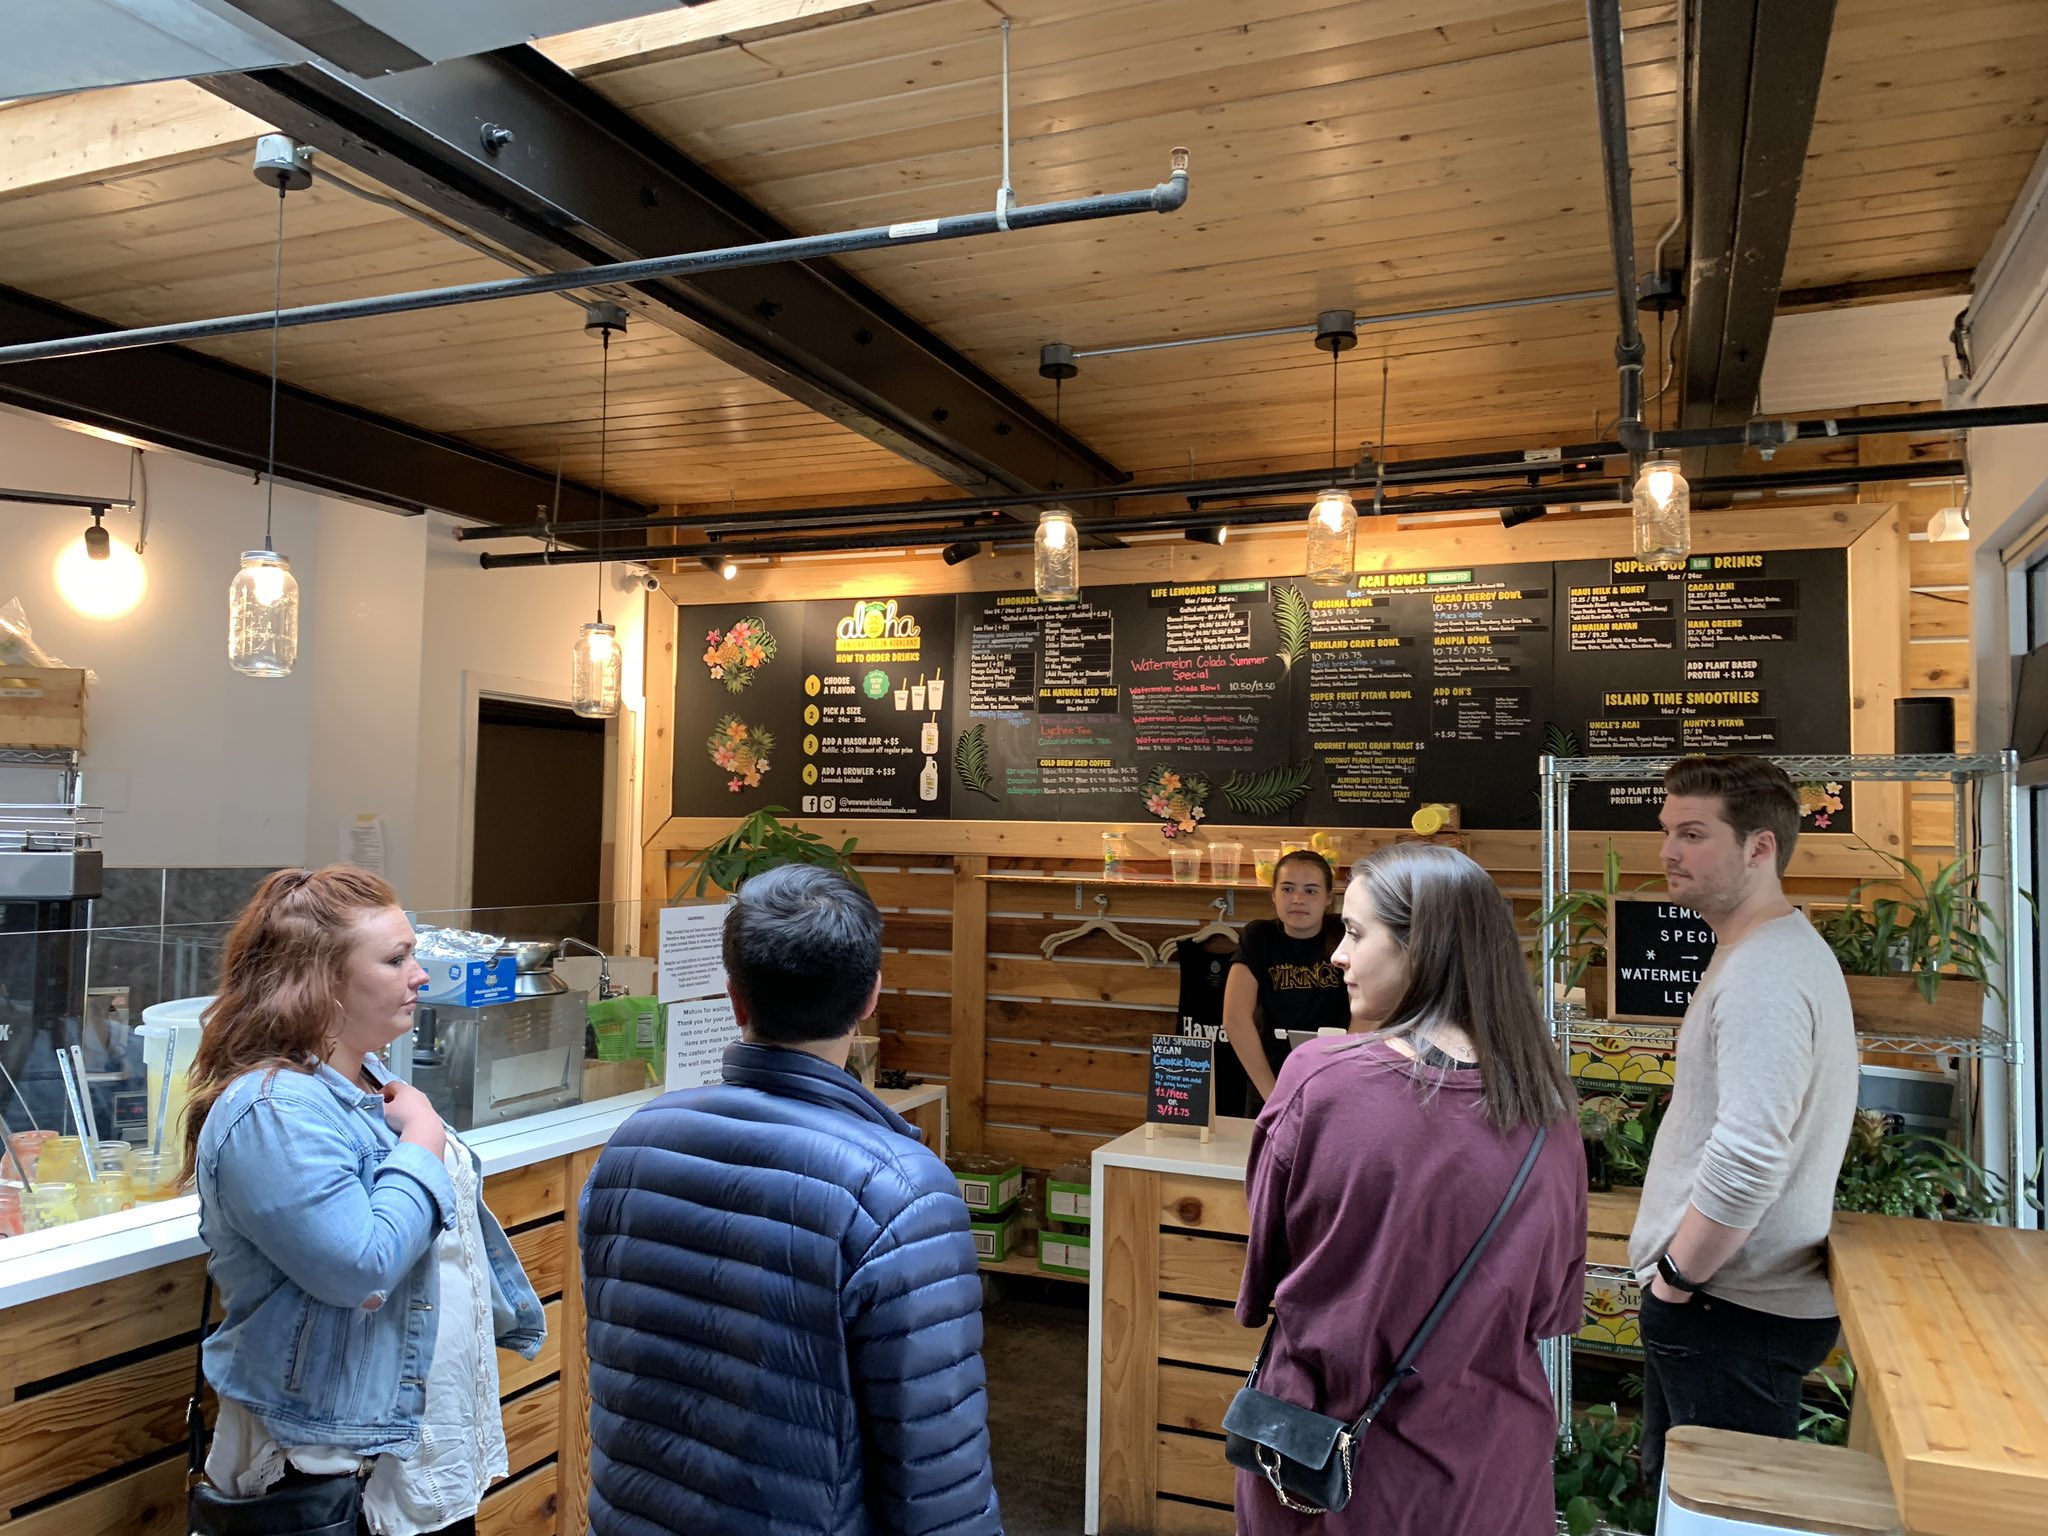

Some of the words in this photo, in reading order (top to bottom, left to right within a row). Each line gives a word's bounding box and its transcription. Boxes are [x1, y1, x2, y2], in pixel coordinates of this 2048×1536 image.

[1693, 559, 1708, 568] RAW
[1714, 555, 1763, 569] DRINKS
[1358, 575, 1386, 588] ACAI
[1388, 573, 1426, 586] BOWLS
[1151, 588, 1168, 598] LIFE
[1169, 586, 1217, 596] LEMONADES
[1570, 588, 1591, 596] MAUI
[1592, 587, 1611, 595] MILK
[1620, 585, 1646, 594] HONEY
[1687, 583, 1714, 592] CACAO
[1716, 582, 1735, 591] LANI
[996, 596, 1040, 606] LEMONADES
[1434, 594, 1462, 604] CACAO
[1464, 592, 1497, 602] ENERGY
[1498, 591, 1522, 600] BOWL
[1312, 599, 1349, 609] ORIGINAL
[1351, 598, 1373, 607] BOWL
[1432, 603, 1460, 612] 10.75
[836, 599, 921, 640] aloha
[1687, 620, 1710, 628] HANA
[1711, 619, 1742, 628] GREENS
[1571, 623, 1610, 632] HAWAIIAN
[1611, 622, 1638, 631] MAYAN
[889, 639, 918, 647] KIRKLAND
[1310, 640, 1348, 650] KIRKLAND
[1349, 639, 1376, 648] CRAVE
[1377, 638, 1400, 647] BOWL
[1434, 637, 1466, 646] HAUPIA
[1467, 636, 1491, 645] BOWL
[836, 654, 853, 663] HOW
[855, 653, 865, 663] TO
[865, 653, 891, 663] ORDER
[892, 652, 920, 662] DRINKS
[1130, 656, 1193, 672] Watermelon
[1196, 654, 1226, 668] Colada
[1229, 653, 1269, 667] Summer
[1687, 662, 1703, 670] ADD
[1705, 661, 1730, 670] PLANT
[1731, 661, 1758, 669] BASED
[1172, 668, 1209, 680] Special
[1687, 671, 1720, 679] PROTEIN
[1723, 670, 1755, 679] +$1.50
[823, 677, 850, 685] CHOOSE
[823, 686, 829, 694] A
[830, 686, 856, 695] FLAVOR
[1039, 688, 1051, 697] ALL
[1052, 688, 1082, 697] NATURAL
[1084, 688, 1100, 696] ICED
[1100, 687, 1118, 697] TEAS
[1129, 685, 1172, 695] Watermelon
[1174, 684, 1198, 693] Colada
[1200, 683, 1221, 692] Bowl
[1433, 687, 1450, 696] ADD
[1452, 687, 1472, 696] ON'S
[1310, 692, 1334, 701] SUPER
[1336, 692, 1359, 700] FRUIT
[1361, 691, 1387, 700] PITAYA
[1389, 691, 1412, 699] BOWL
[1605, 693, 1649, 706] ISLAND
[1652, 692, 1683, 705] TIME
[1686, 691, 1759, 705] SMOOTHIES
[823, 707, 839, 715] PICK
[840, 707, 846, 715] A
[846, 706, 861, 715] SIZE
[1133, 715, 1177, 725] Watermelon
[1180, 715, 1202, 723] Colada
[1589, 721, 1620, 729] UNCLE'S
[1621, 720, 1640, 729] ACAI
[1683, 719, 1716, 728] AUNTY'S
[1717, 719, 1744, 727] PITAYA
[821, 738, 836, 746] ADD
[843, 738, 867, 746] MASON
[868, 738, 882, 746] JAR
[1136, 736, 1183, 745] Watermelon
[1184, 736, 1209, 744] Colada
[1212, 735, 1254, 745] Lemonade
[1314, 742, 1346, 750] GOURMET
[1347, 742, 1368, 750] MULTI
[1369, 742, 1391, 750] GRAIN
[1392, 742, 1414, 750] TOAST
[1415, 742, 1425, 751] $5
[1040, 759, 1056, 767] COLD
[1056, 759, 1074, 767] BREW
[1074, 759, 1088, 767] ICED
[1089, 759, 1112, 767] COFFEE
[821, 768, 836, 776] ADD
[843, 767, 874, 776] GROWLER
[1384, 777, 1403, 785] TOAST
[1333, 790, 1371, 798] STRAWBERRY
[1372, 790, 1391, 798] CACAO
[1392, 790, 1411, 798] TOAST
[1610, 787, 1626, 795] ADD
[1627, 786, 1652, 795] PLANT
[1653, 786, 1668, 795] BAS
[1610, 796, 1643, 805] PROTEIN
[1645, 796, 1665, 805] +$1.
[1658, 906, 1702, 919] LEMO
[1660, 929, 1715, 944] SPECI
[1268, 961, 1341, 991] VIKINGS
[1621, 967, 1706, 983] WATERMEL
[712, 1016, 724, 1024] your
[1183, 1016, 1229, 1042] Hawa
[1152, 1036, 1170, 1045] RAW
[1173, 1037, 1211, 1049] SPROUTED
[1152, 1045, 1182, 1055] VEGAN
[1153, 1054, 1183, 1067] Cookie
[1184, 1057, 1211, 1072] Dough
[1571, 1340, 1612, 1351] Premium
[1614, 1345, 1646, 1356] Lemon
